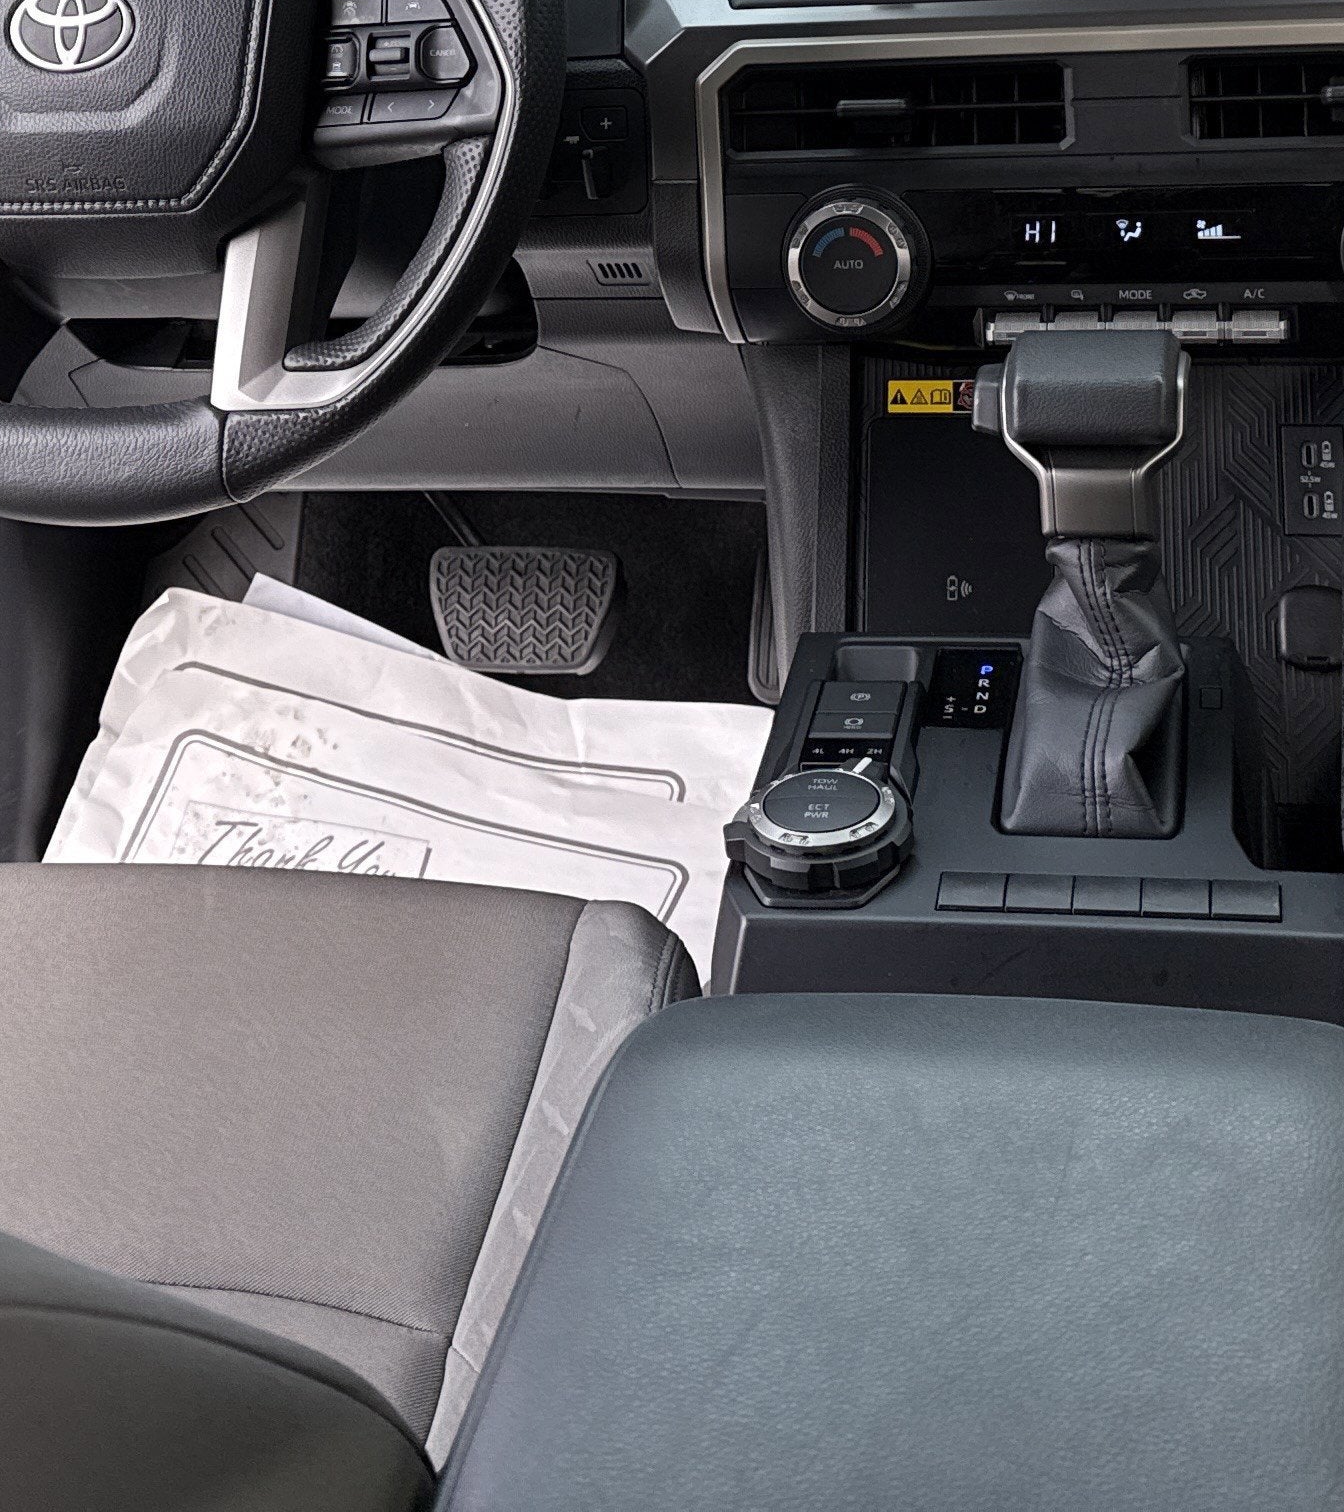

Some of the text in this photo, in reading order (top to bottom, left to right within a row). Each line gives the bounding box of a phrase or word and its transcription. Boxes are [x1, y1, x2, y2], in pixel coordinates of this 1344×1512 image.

[326, 106, 352, 115] MODE
[26, 177, 128, 193] SRS AIRBAG
[1024, 220, 1056, 243] HI
[834, 260, 864, 269] AUTO
[1118, 290, 1152, 300] MODE
[1243, 288, 1265, 300] A/C
[980, 665, 994, 675] P
[978, 679, 990, 688] R
[976, 691, 989, 700] N
[944, 704, 987, 714] S D
[198, 820, 335, 870] Thank
